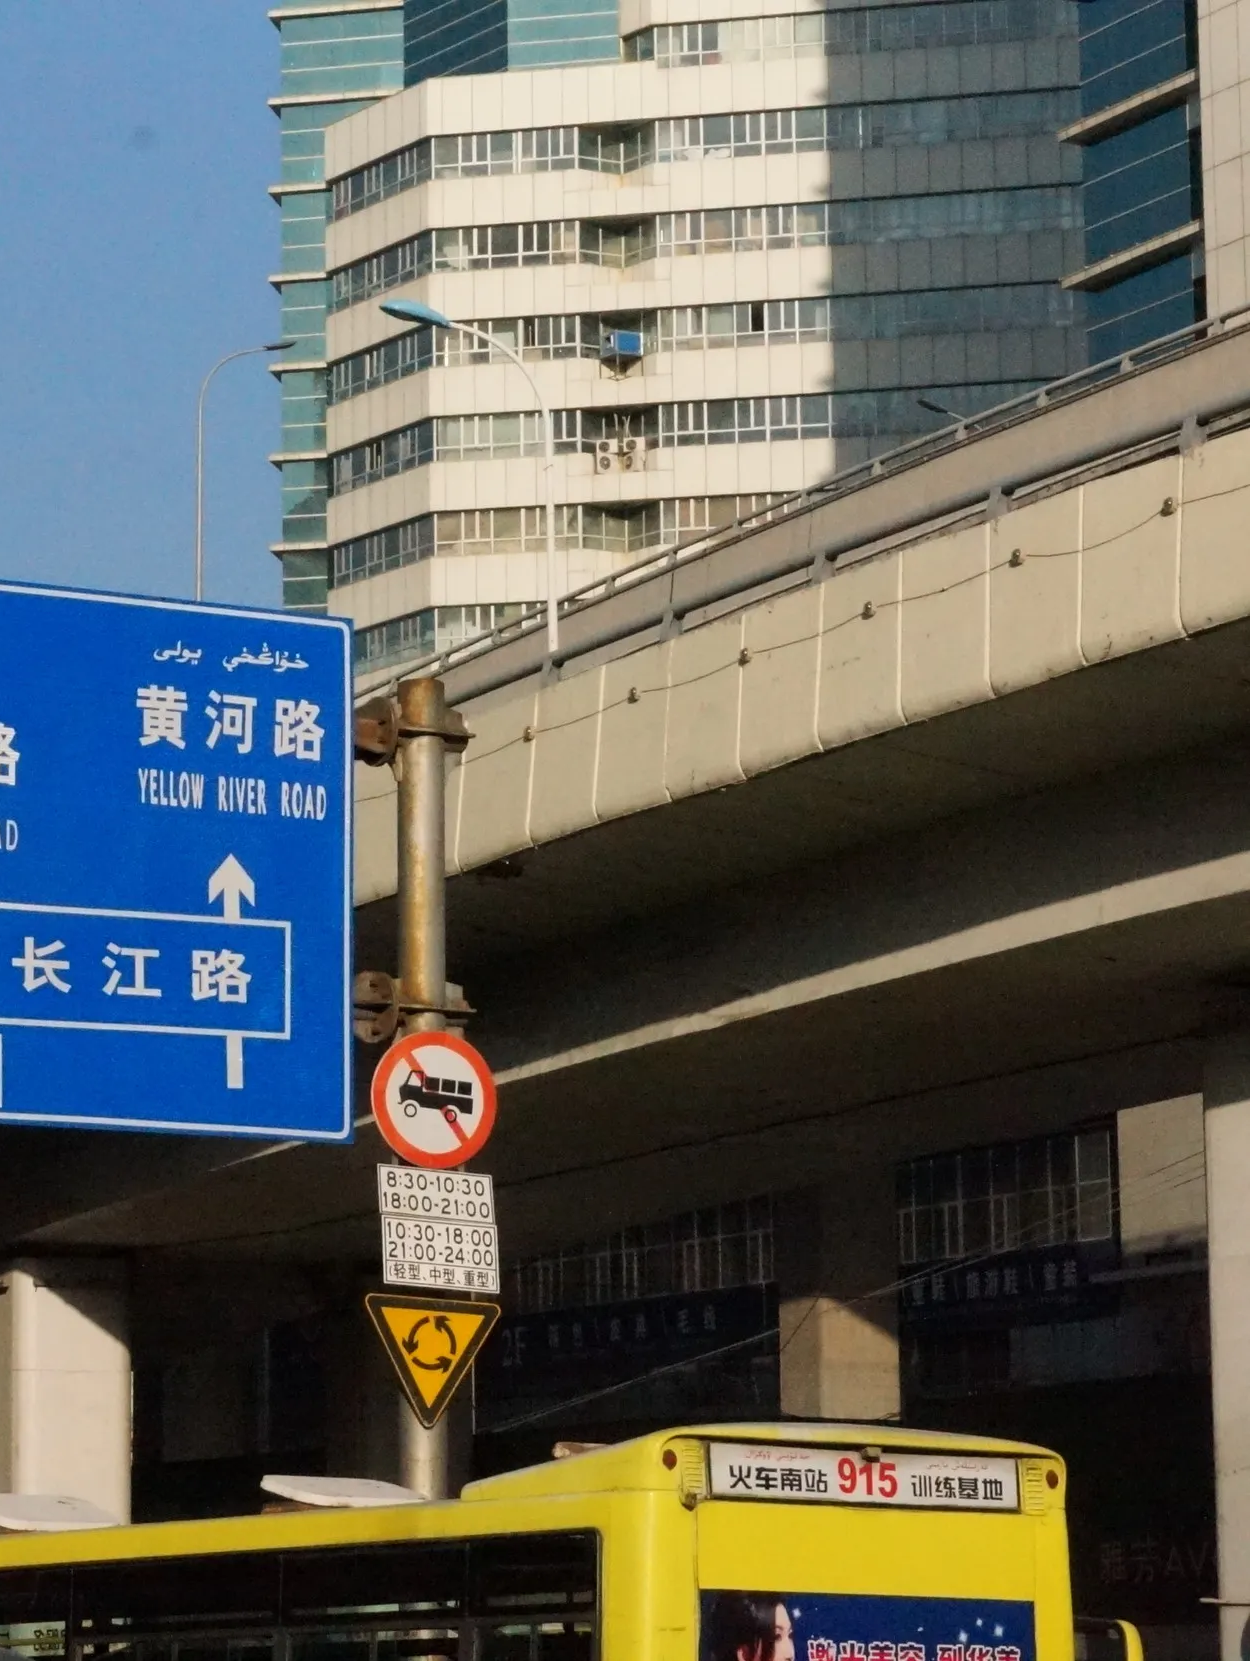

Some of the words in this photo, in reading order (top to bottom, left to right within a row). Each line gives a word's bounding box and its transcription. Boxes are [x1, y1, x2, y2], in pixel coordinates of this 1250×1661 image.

[136, 684, 326, 762] 黄河路
[138, 768, 205, 810] YELLOW
[218, 774, 268, 816] RIVER
[281, 781, 328, 821] ROAD
[11, 936, 252, 1004] 长江路
[387, 1171, 484, 1196] 8:30-10:30
[383, 1191, 489, 1218] 18:00-21:00
[387, 1221, 492, 1247] 10:30-18:00
[388, 1240, 494, 1267] 21:00-24:00
[729, 1464, 829, 1493] 火车南站
[837, 1457, 898, 1498] 915
[910, 1473, 1003, 1501] 训练基地
